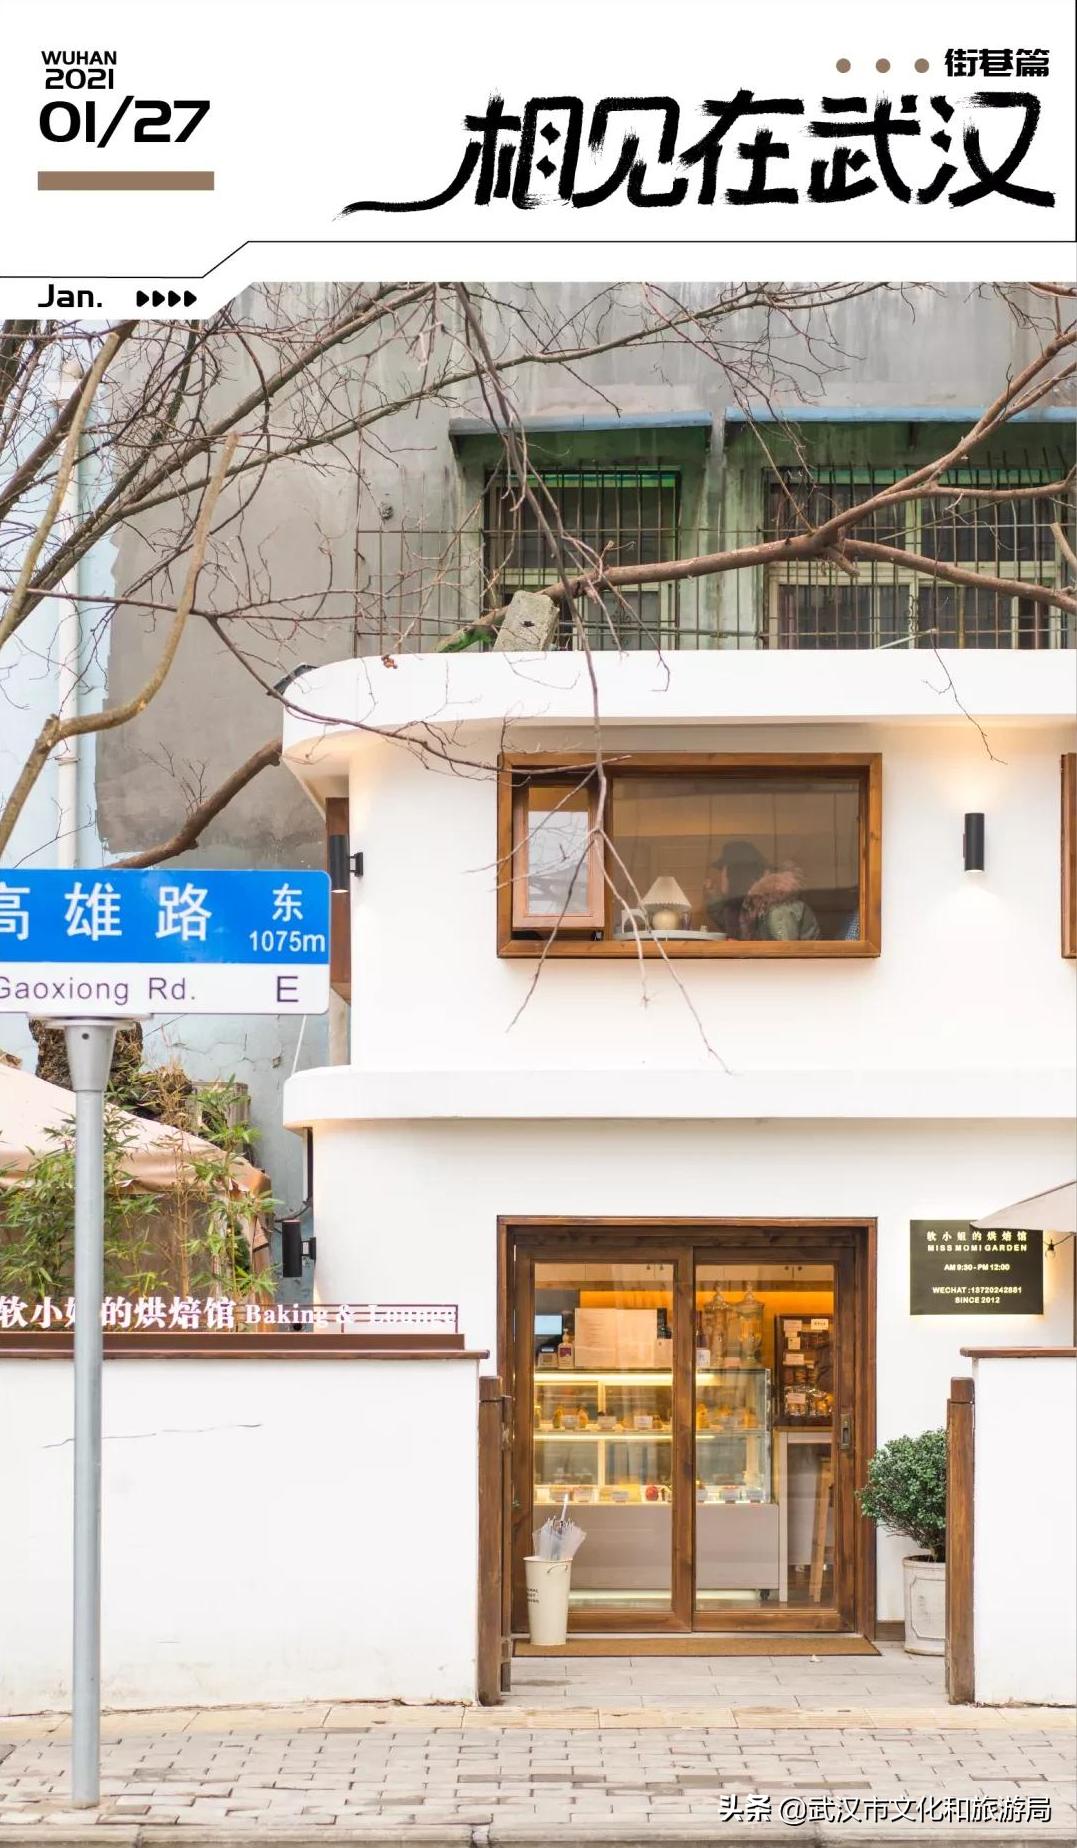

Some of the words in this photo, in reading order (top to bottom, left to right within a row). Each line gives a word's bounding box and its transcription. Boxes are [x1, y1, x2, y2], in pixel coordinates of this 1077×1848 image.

[272, 883, 304, 923] 东
[249, 930, 326, 953] 1075m
[0, 976, 129, 1006] Gaoxiong
[149, 977, 196, 1000] Rd.
[276, 976, 299, 1003] E
[927, 1244, 953, 1252] MISS
[954, 1244, 982, 1252] MOMI
[984, 1244, 1028, 1252] GARDEN
[932, 1286, 967, 1294] WECHAT
[954, 1296, 980, 1304] SINCE
[980, 1296, 1001, 1304] 2012
[245, 1304, 329, 1328] Baking
[335, 1304, 356, 1324] &
